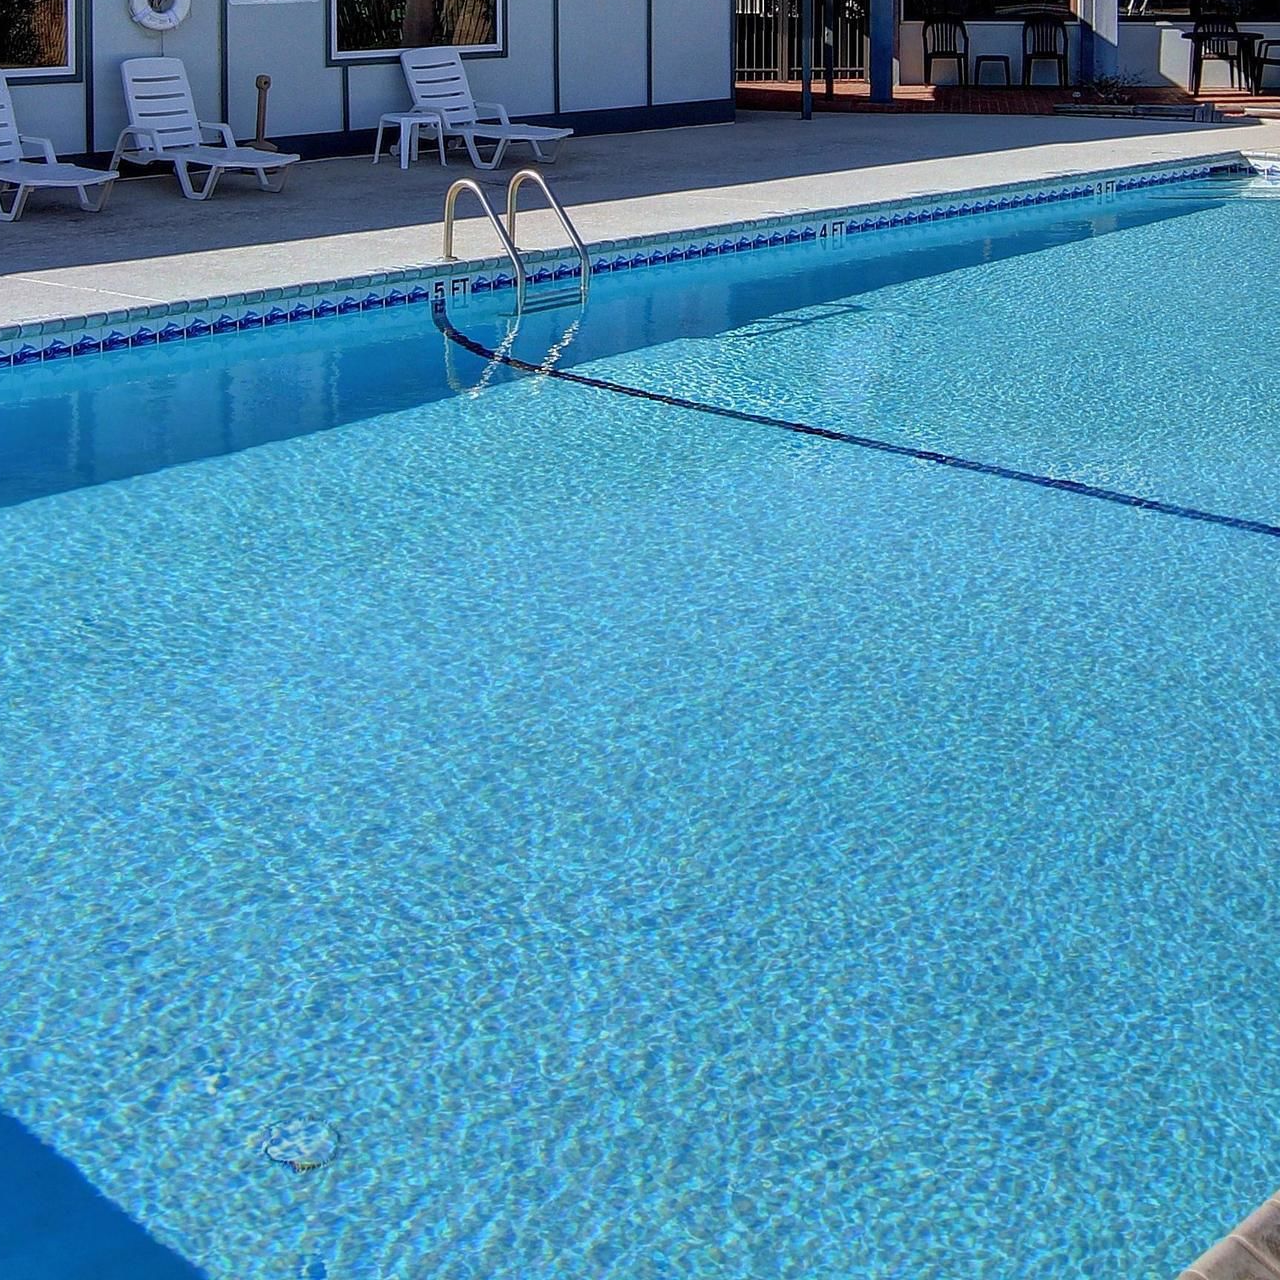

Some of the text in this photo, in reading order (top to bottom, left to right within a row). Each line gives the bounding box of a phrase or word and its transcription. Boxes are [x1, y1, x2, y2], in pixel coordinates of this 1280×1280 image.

[1096, 180, 1116, 195] 3 FT
[819, 221, 845, 237] 4 FT
[434, 277, 469, 299] 5 FT
